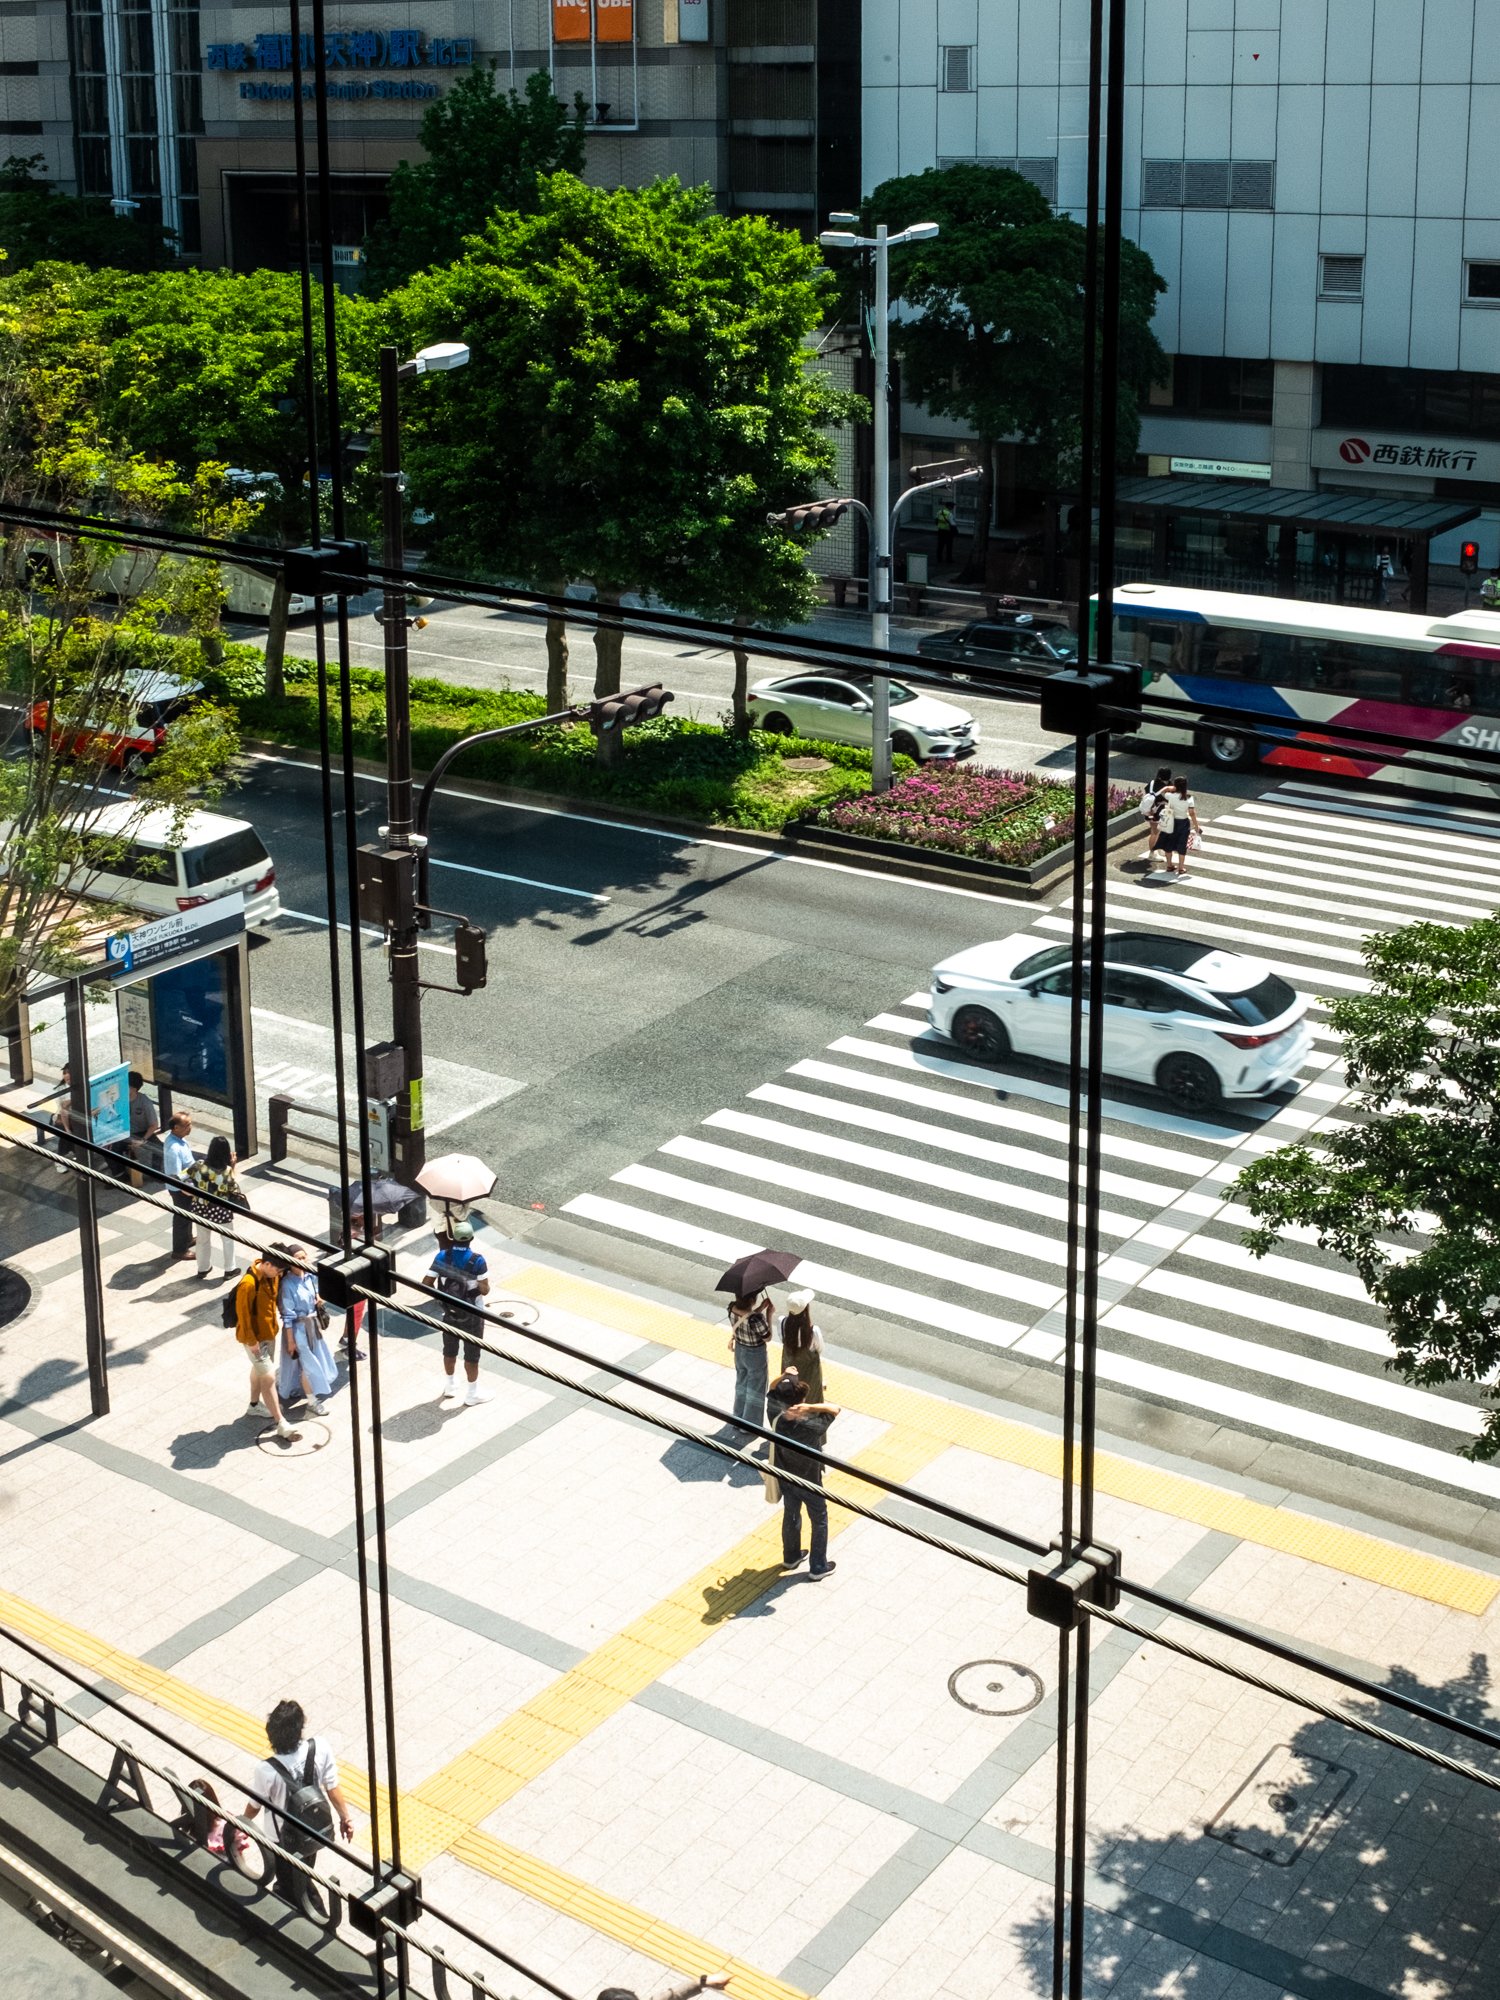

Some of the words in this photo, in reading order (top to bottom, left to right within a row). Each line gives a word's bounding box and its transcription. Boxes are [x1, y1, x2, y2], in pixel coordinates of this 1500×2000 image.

[1373, 444, 1477, 471] 西鉄旅行
[1457, 726, 1500, 751] SH
[132, 917, 183, 943] 天神ワンビル前
